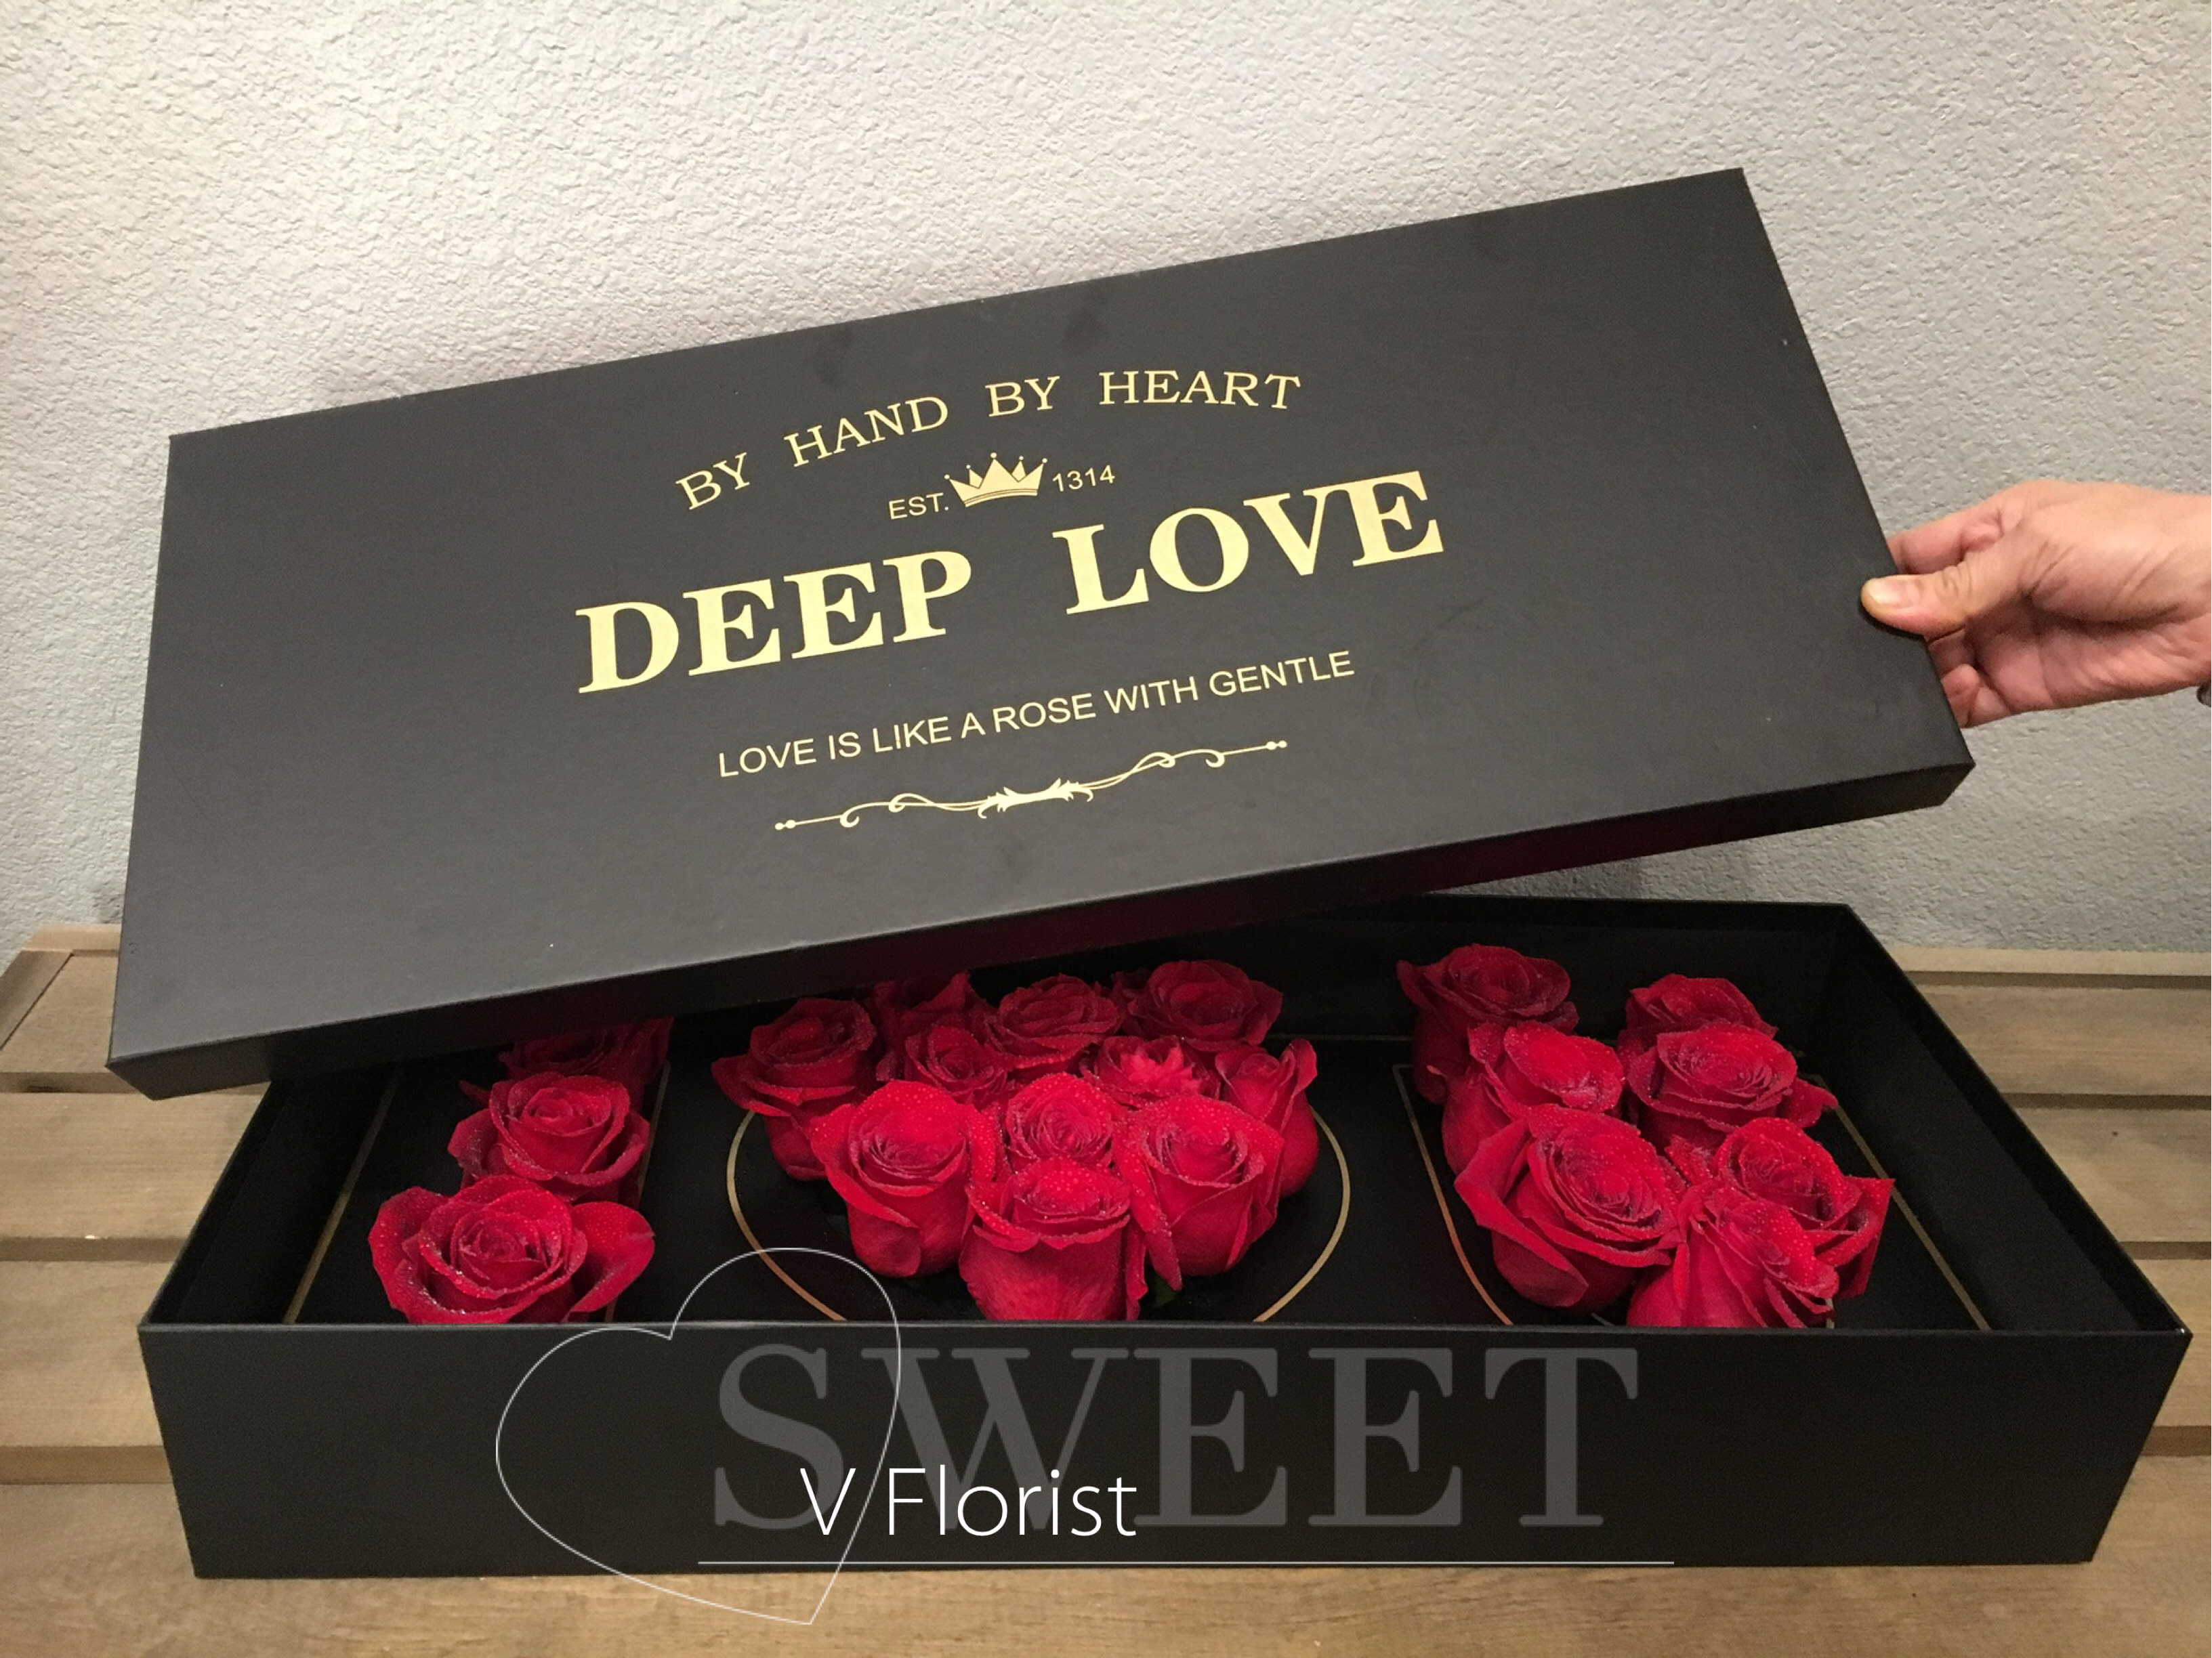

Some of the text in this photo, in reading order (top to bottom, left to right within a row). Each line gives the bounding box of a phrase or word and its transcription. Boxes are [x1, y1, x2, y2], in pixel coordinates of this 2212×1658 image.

[673, 368, 1302, 511] BY HAND BY HEART
[1051, 464, 1117, 493] 1314
[888, 492, 950, 520] EST.
[574, 469, 1445, 695] DEEP LOVE
[717, 650, 1356, 779] LOVE IS LIKE A ROSE WITH GENTLE
